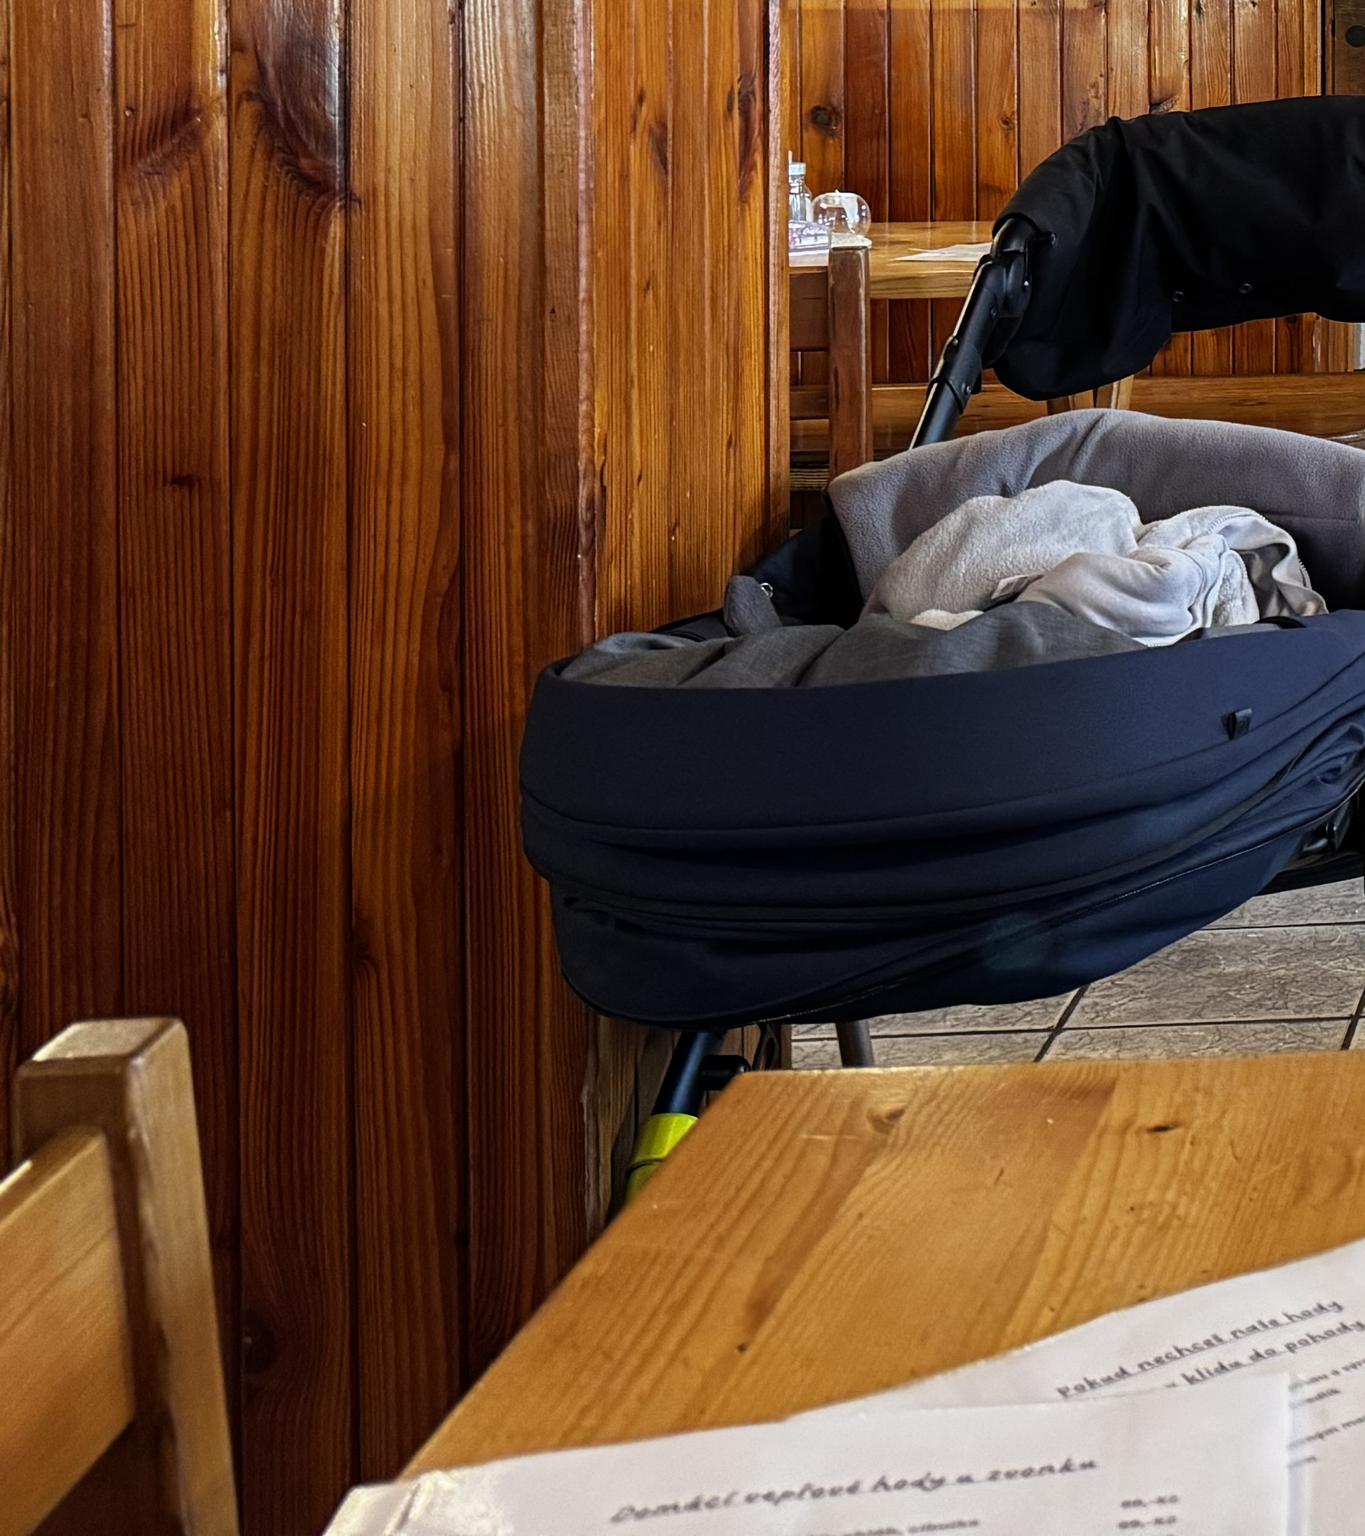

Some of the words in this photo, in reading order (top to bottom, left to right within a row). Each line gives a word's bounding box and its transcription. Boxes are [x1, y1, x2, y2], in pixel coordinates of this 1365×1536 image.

[1056, 1363, 1129, 1399] Pokud
[1283, 1298, 1346, 1328] hody
[1182, 1353, 1241, 1387] klidu
[1248, 1341, 1278, 1363] do
[871, 1470, 947, 1493] hody
[985, 1456, 1099, 1484] zvonku
